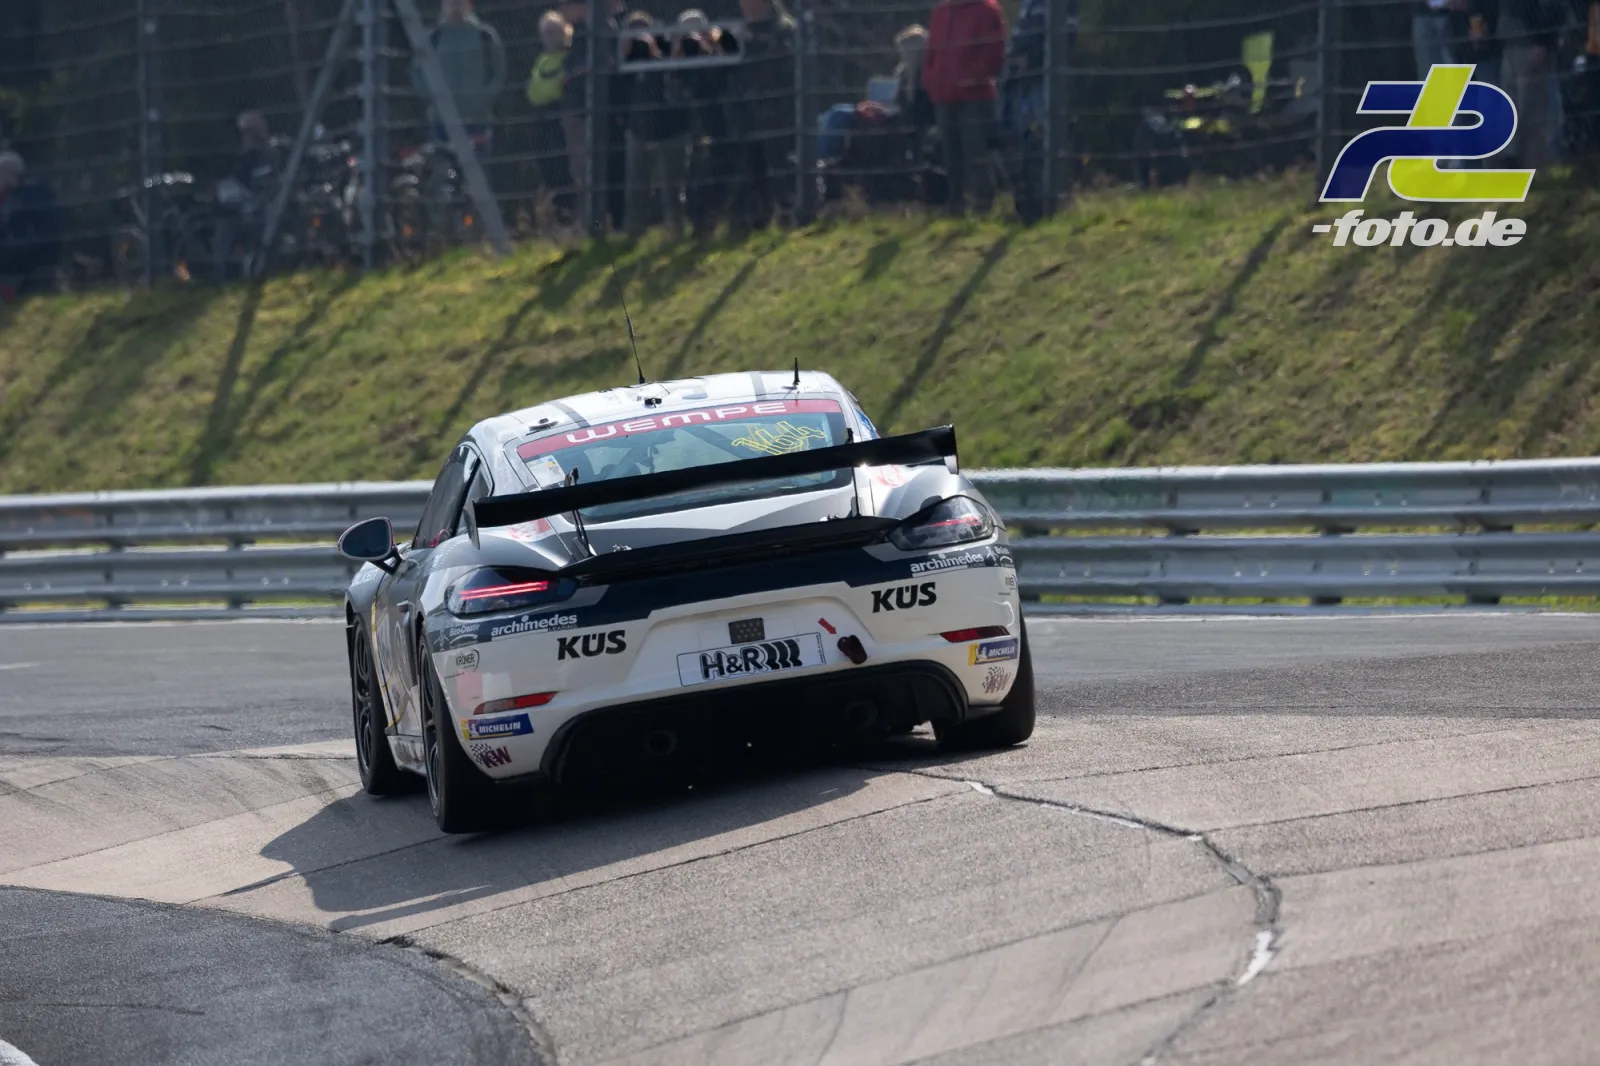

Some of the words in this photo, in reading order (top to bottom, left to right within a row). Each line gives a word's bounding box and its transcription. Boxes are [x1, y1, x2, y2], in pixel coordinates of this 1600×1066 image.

[566, 401, 788, 444] WEMPE
[910, 552, 985, 573] archimedes
[871, 582, 937, 613] KÜS
[491, 613, 578, 637] archimedes
[557, 629, 627, 660] KÜS
[988, 646, 1016, 657] MICHELIN
[701, 647, 765, 680] H&R
[479, 721, 521, 733] MICHELIN
